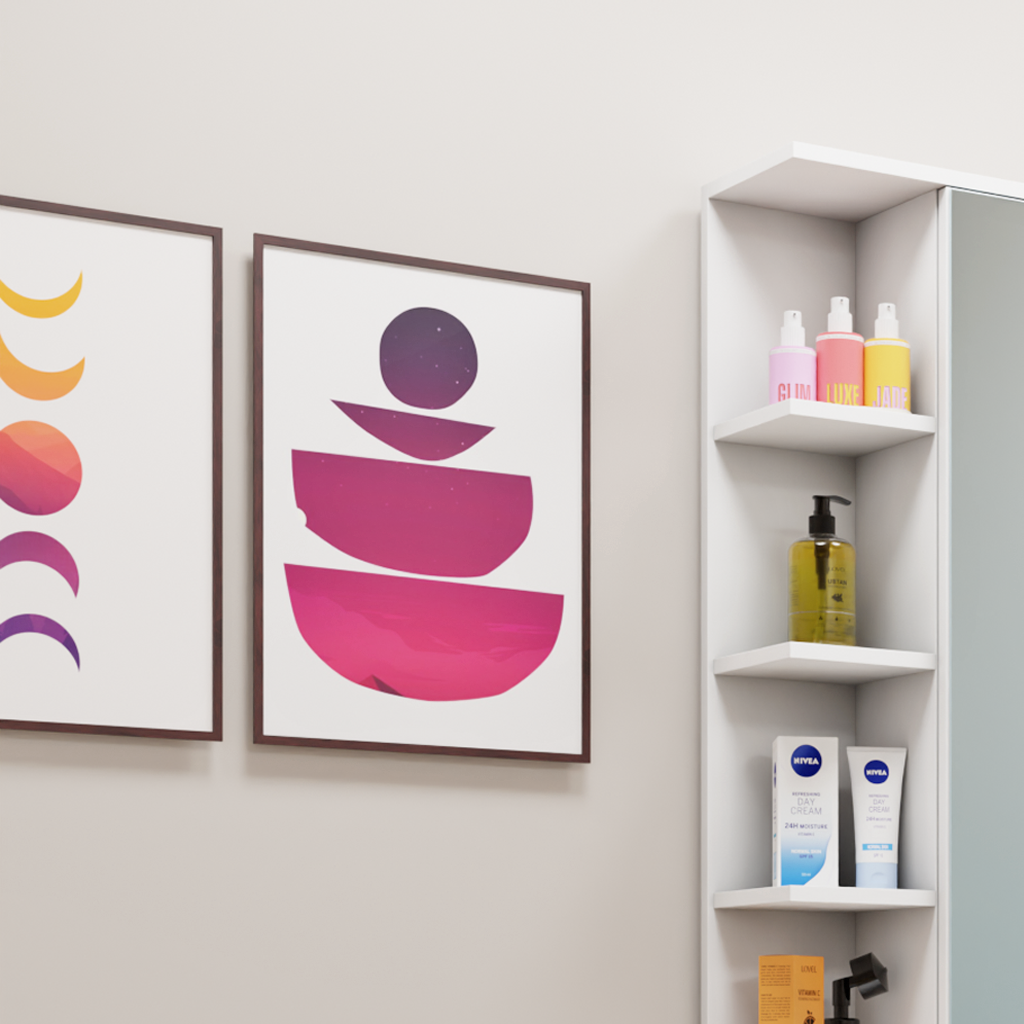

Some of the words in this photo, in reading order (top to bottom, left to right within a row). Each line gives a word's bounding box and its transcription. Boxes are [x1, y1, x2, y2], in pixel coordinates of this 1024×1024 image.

[778, 383, 811, 402] GLIM
[826, 383, 860, 406] LUXE
[872, 386, 908, 410] JADE
[793, 757, 819, 765] NIVEA
[797, 797, 815, 806] DAY
[790, 806, 822, 815] CREAM
